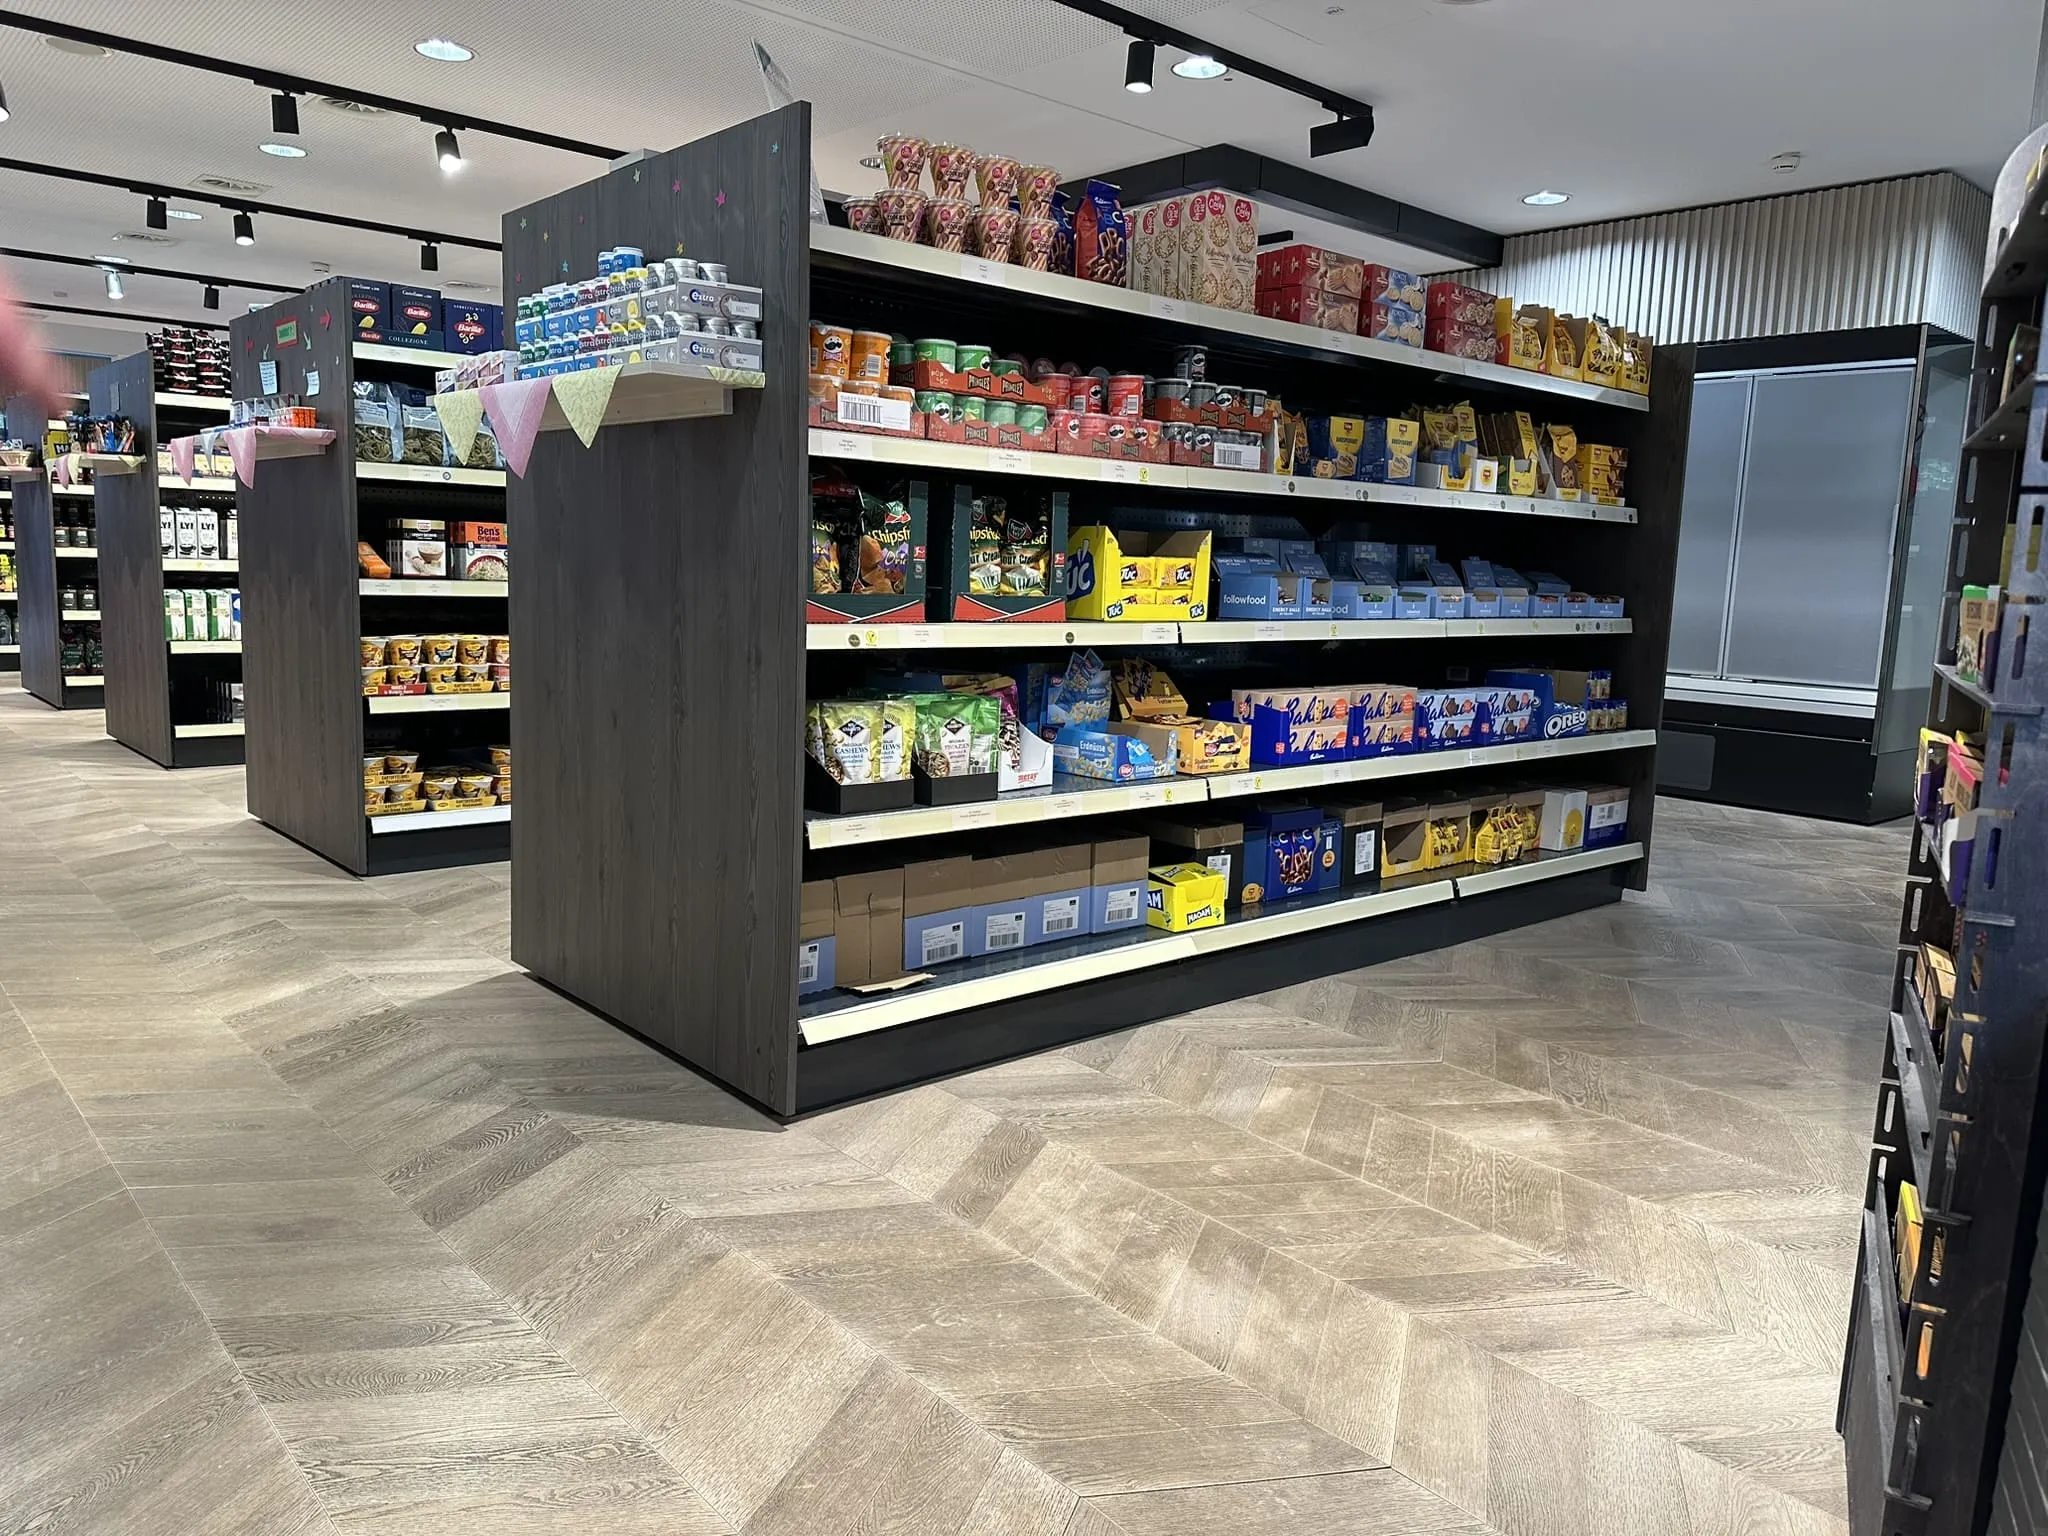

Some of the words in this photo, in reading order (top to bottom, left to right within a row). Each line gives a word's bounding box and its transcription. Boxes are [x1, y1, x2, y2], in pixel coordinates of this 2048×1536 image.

[691, 290, 715, 302] extra
[407, 308, 430, 319] Barilla
[457, 323, 482, 335] Barilla
[388, 336, 429, 346] COLLEZIONE
[691, 343, 715, 354] extra
[969, 374, 990, 391] PRINGLES
[1002, 378, 1023, 396] PRINGLES
[966, 424, 988, 440] PRINGLES
[1000, 428, 1021, 445] PRINGLES
[180, 521, 194, 530] LY!
[201, 522, 215, 531] LY!
[478, 525, 500, 536] Ben's
[1121, 568, 1137, 580] TUC
[1177, 568, 1191, 580] TUC
[1223, 595, 1266, 606] followfood
[1107, 605, 1123, 617] TUC
[1191, 605, 1204, 617] TUC
[1331, 604, 1349, 614] ood
[1546, 710, 1586, 736] OREO
[834, 746, 868, 755] CASHEWS
[1080, 741, 1106, 753] Erdnüsse
[1018, 772, 1038, 782] meray
[1147, 891, 1162, 909] AM
[1188, 906, 1211, 924] MAOAM
